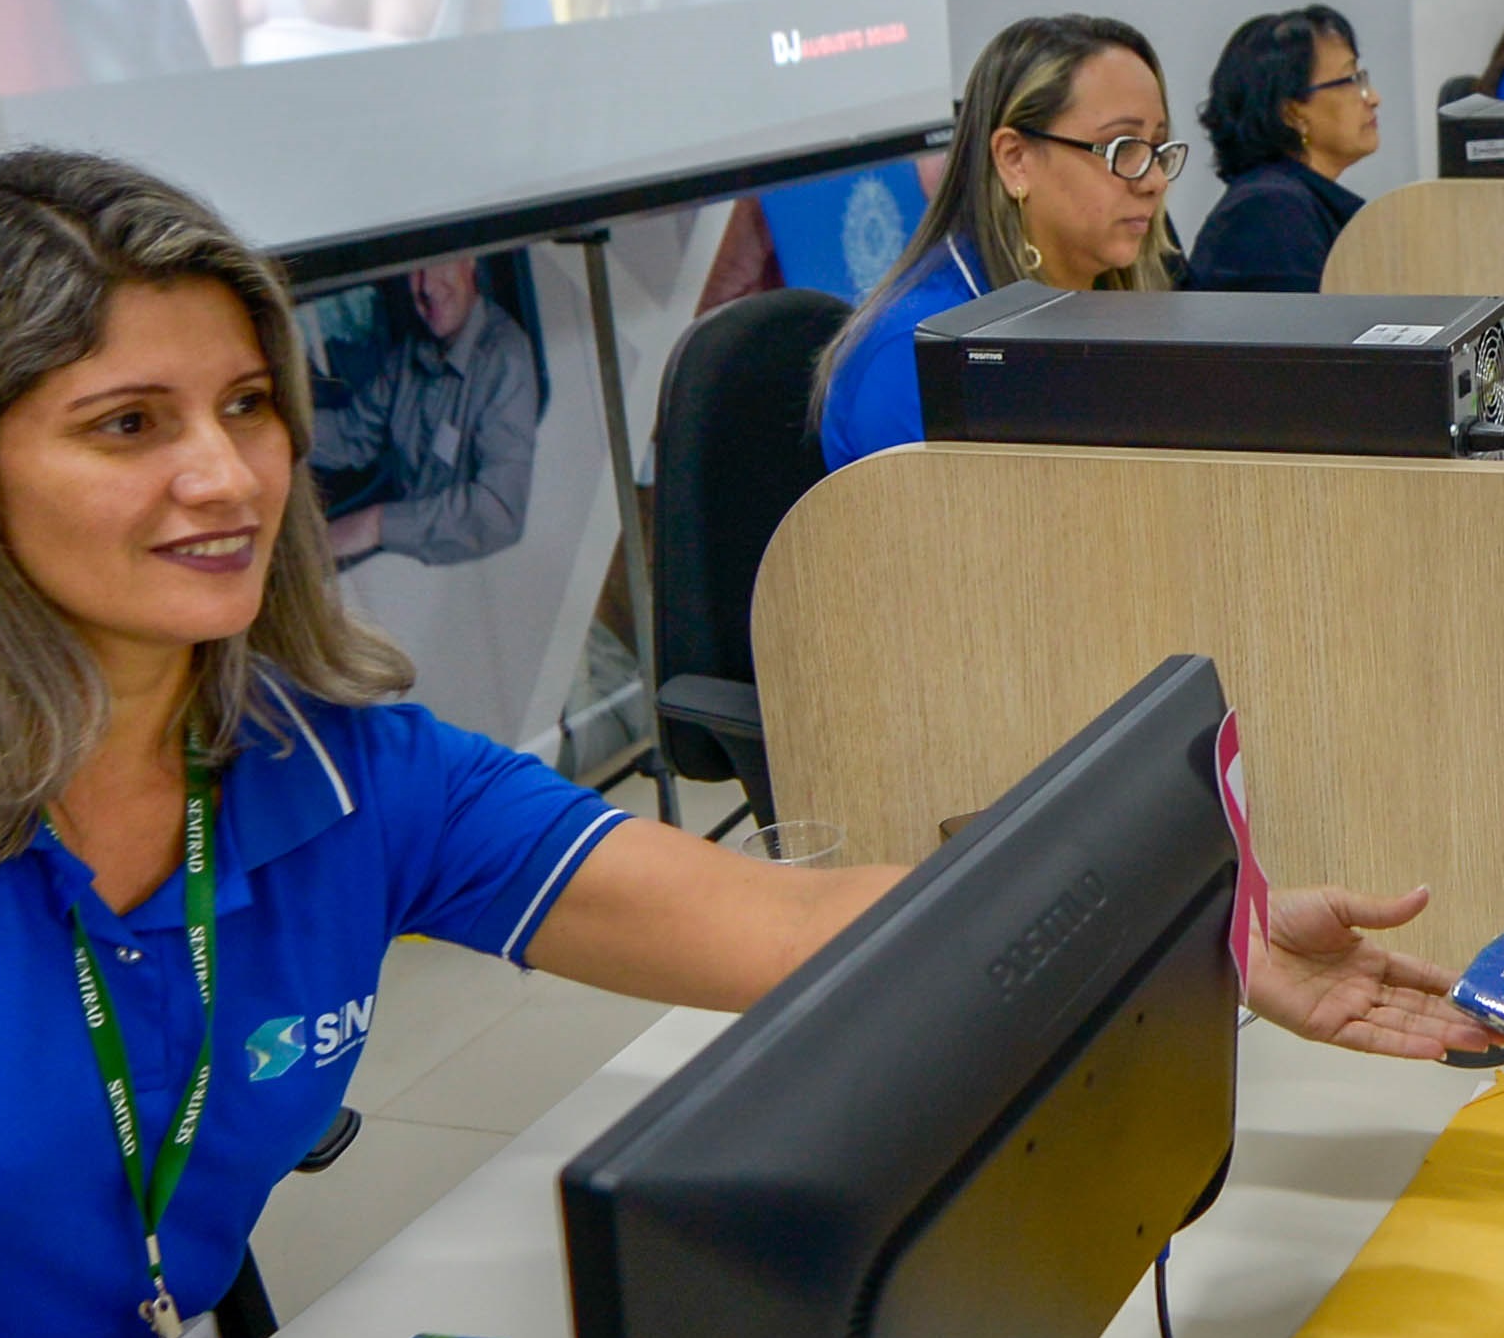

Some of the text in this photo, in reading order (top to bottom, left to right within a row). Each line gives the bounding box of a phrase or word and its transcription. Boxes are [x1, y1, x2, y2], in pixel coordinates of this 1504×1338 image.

[187, 798, 204, 873] SEMTRAD
[75, 946, 105, 1029] SEMTRAD
[107, 1078, 136, 1156] SEMTRAD
[175, 1064, 210, 1145] SEMTRAD
